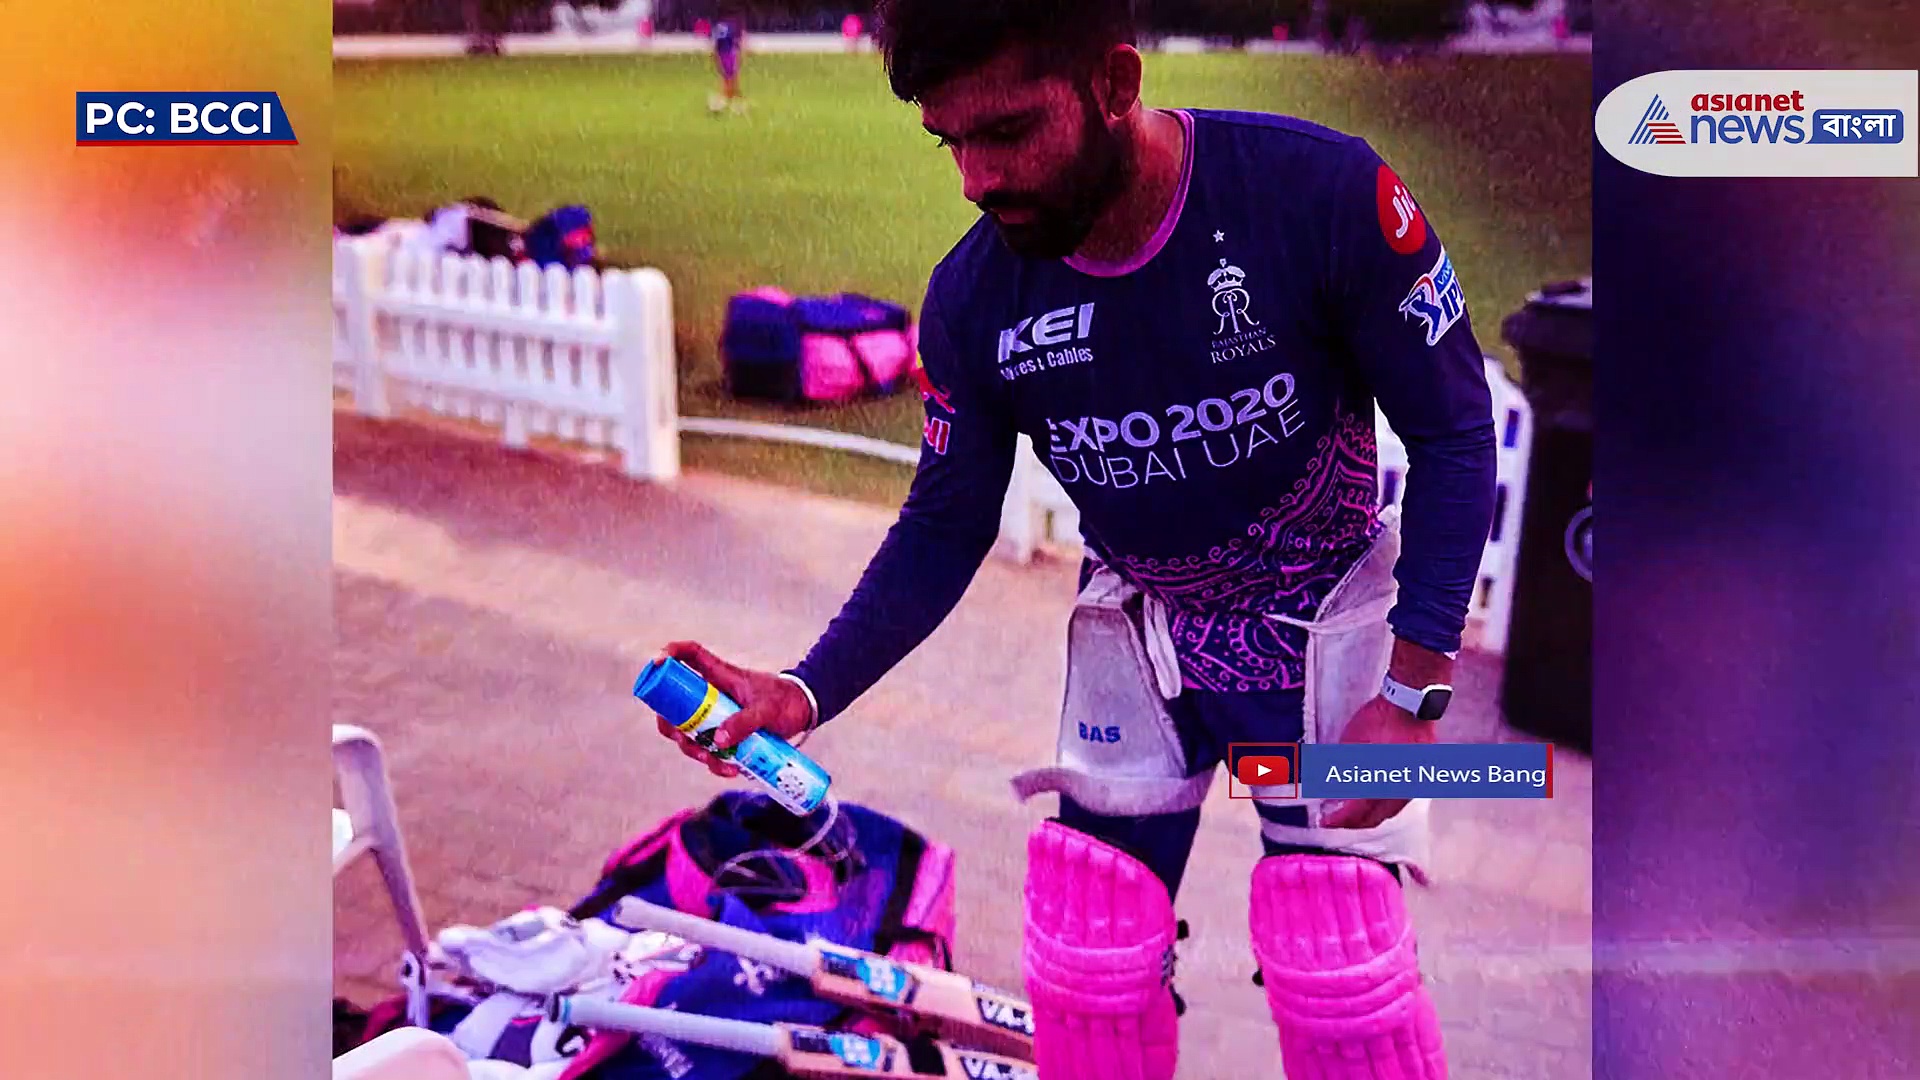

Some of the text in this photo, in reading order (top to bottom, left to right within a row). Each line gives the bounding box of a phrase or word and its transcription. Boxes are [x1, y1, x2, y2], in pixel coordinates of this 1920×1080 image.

[998, 302, 1095, 363] KEI
[1046, 347, 1094, 367] Cables
[1210, 334, 1276, 363] ROYALS
[1045, 373, 1296, 453] EXPO 2020
[1050, 399, 1306, 489] DUBAI UAE
